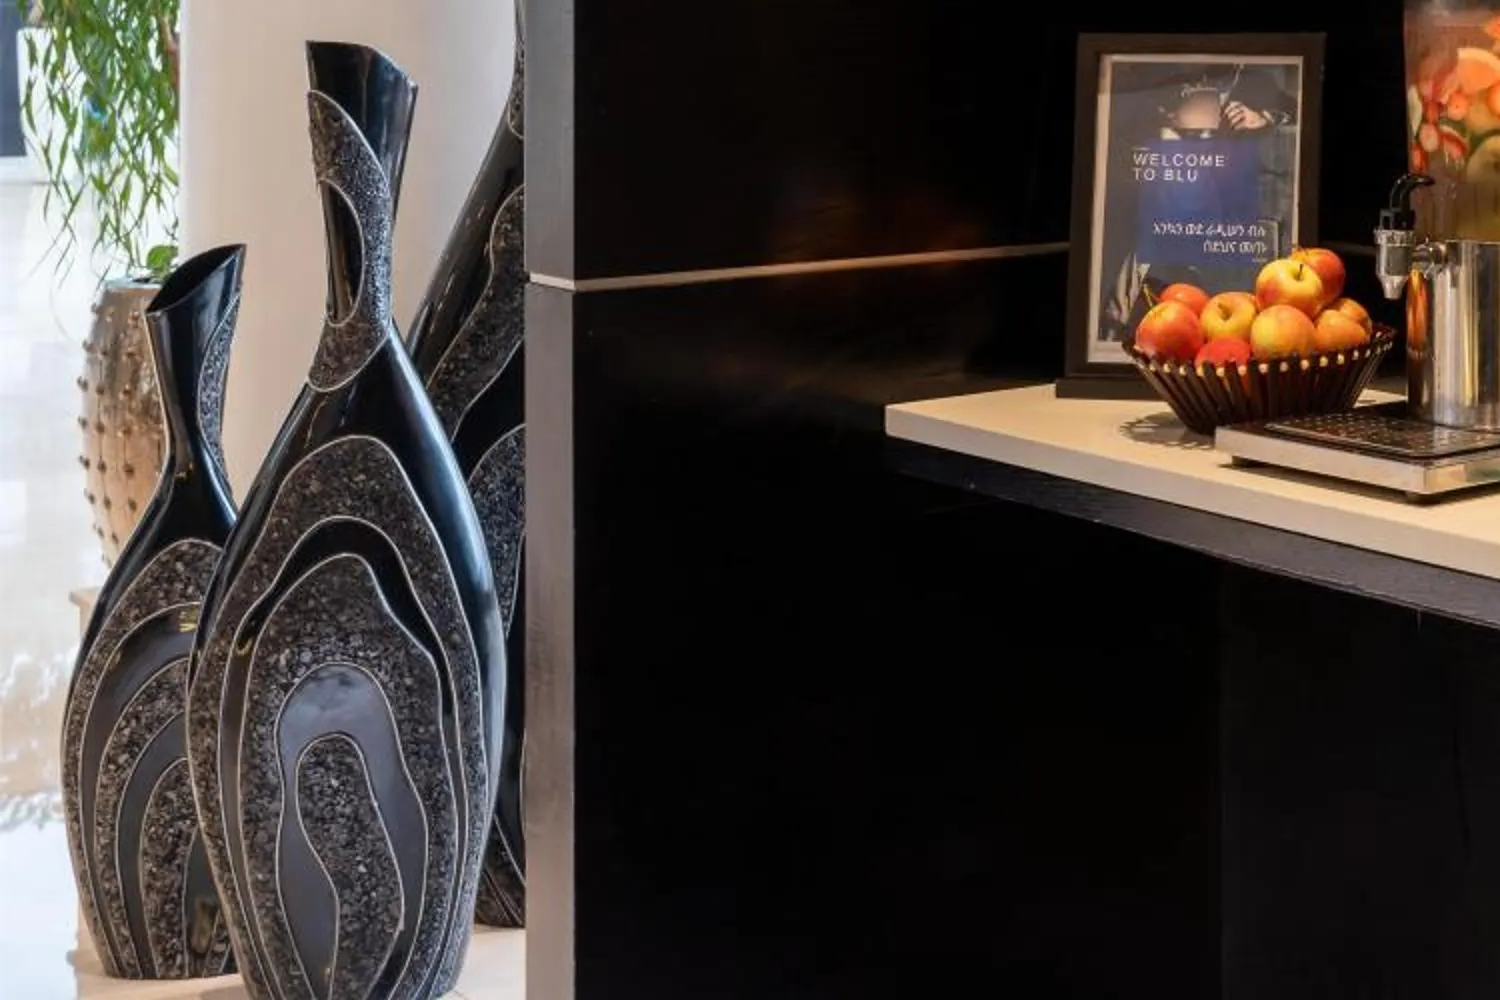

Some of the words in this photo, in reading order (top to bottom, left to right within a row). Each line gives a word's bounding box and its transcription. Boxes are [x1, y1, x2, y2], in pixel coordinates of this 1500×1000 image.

[1133, 153, 1225, 167] WELCOME
[1133, 168, 1156, 181] TO
[1163, 168, 1199, 182] BLU
